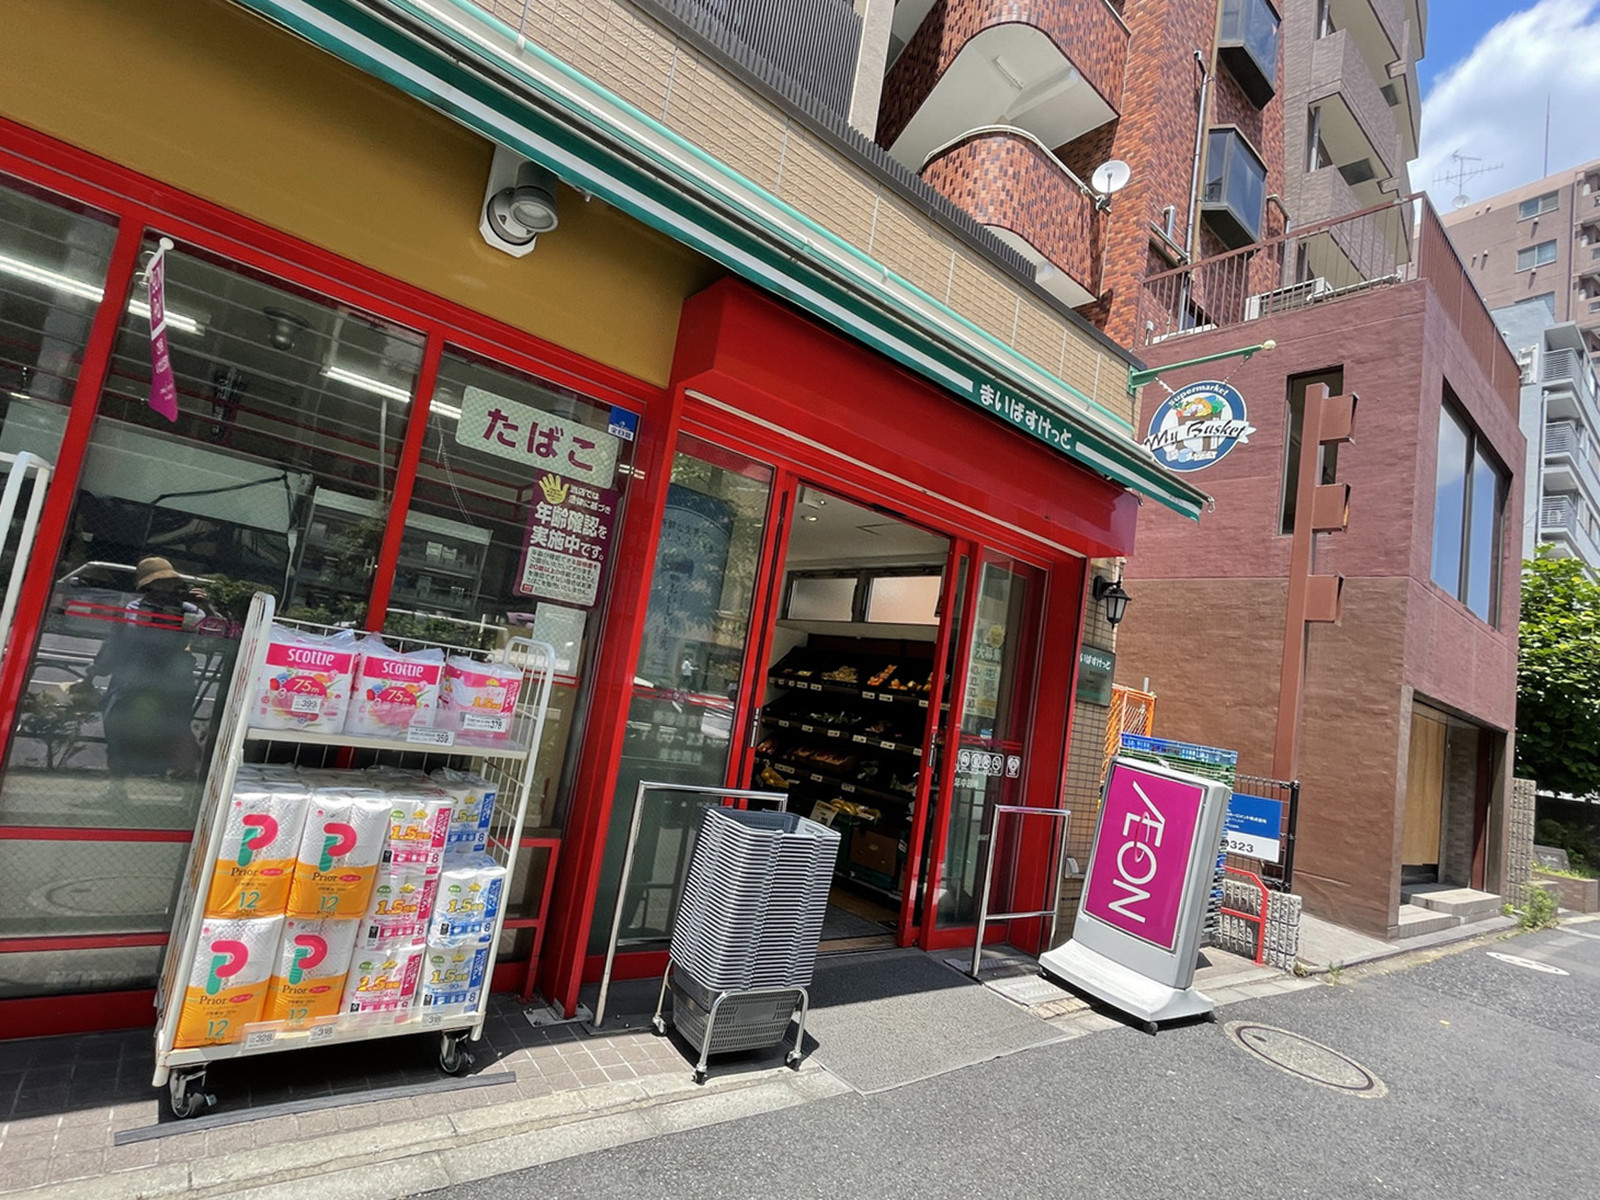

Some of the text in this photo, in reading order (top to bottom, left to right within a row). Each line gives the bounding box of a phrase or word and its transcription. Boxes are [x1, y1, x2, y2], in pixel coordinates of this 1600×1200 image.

[1167, 384, 1230, 407] Supermarket
[979, 383, 1073, 450] まいばすけっと
[1186, 420, 1247, 439] Basket
[483, 408, 596, 472] たばこ
[240, 891, 260, 909] 12
[320, 896, 339, 911] 12
[207, 1020, 228, 1037] 12
